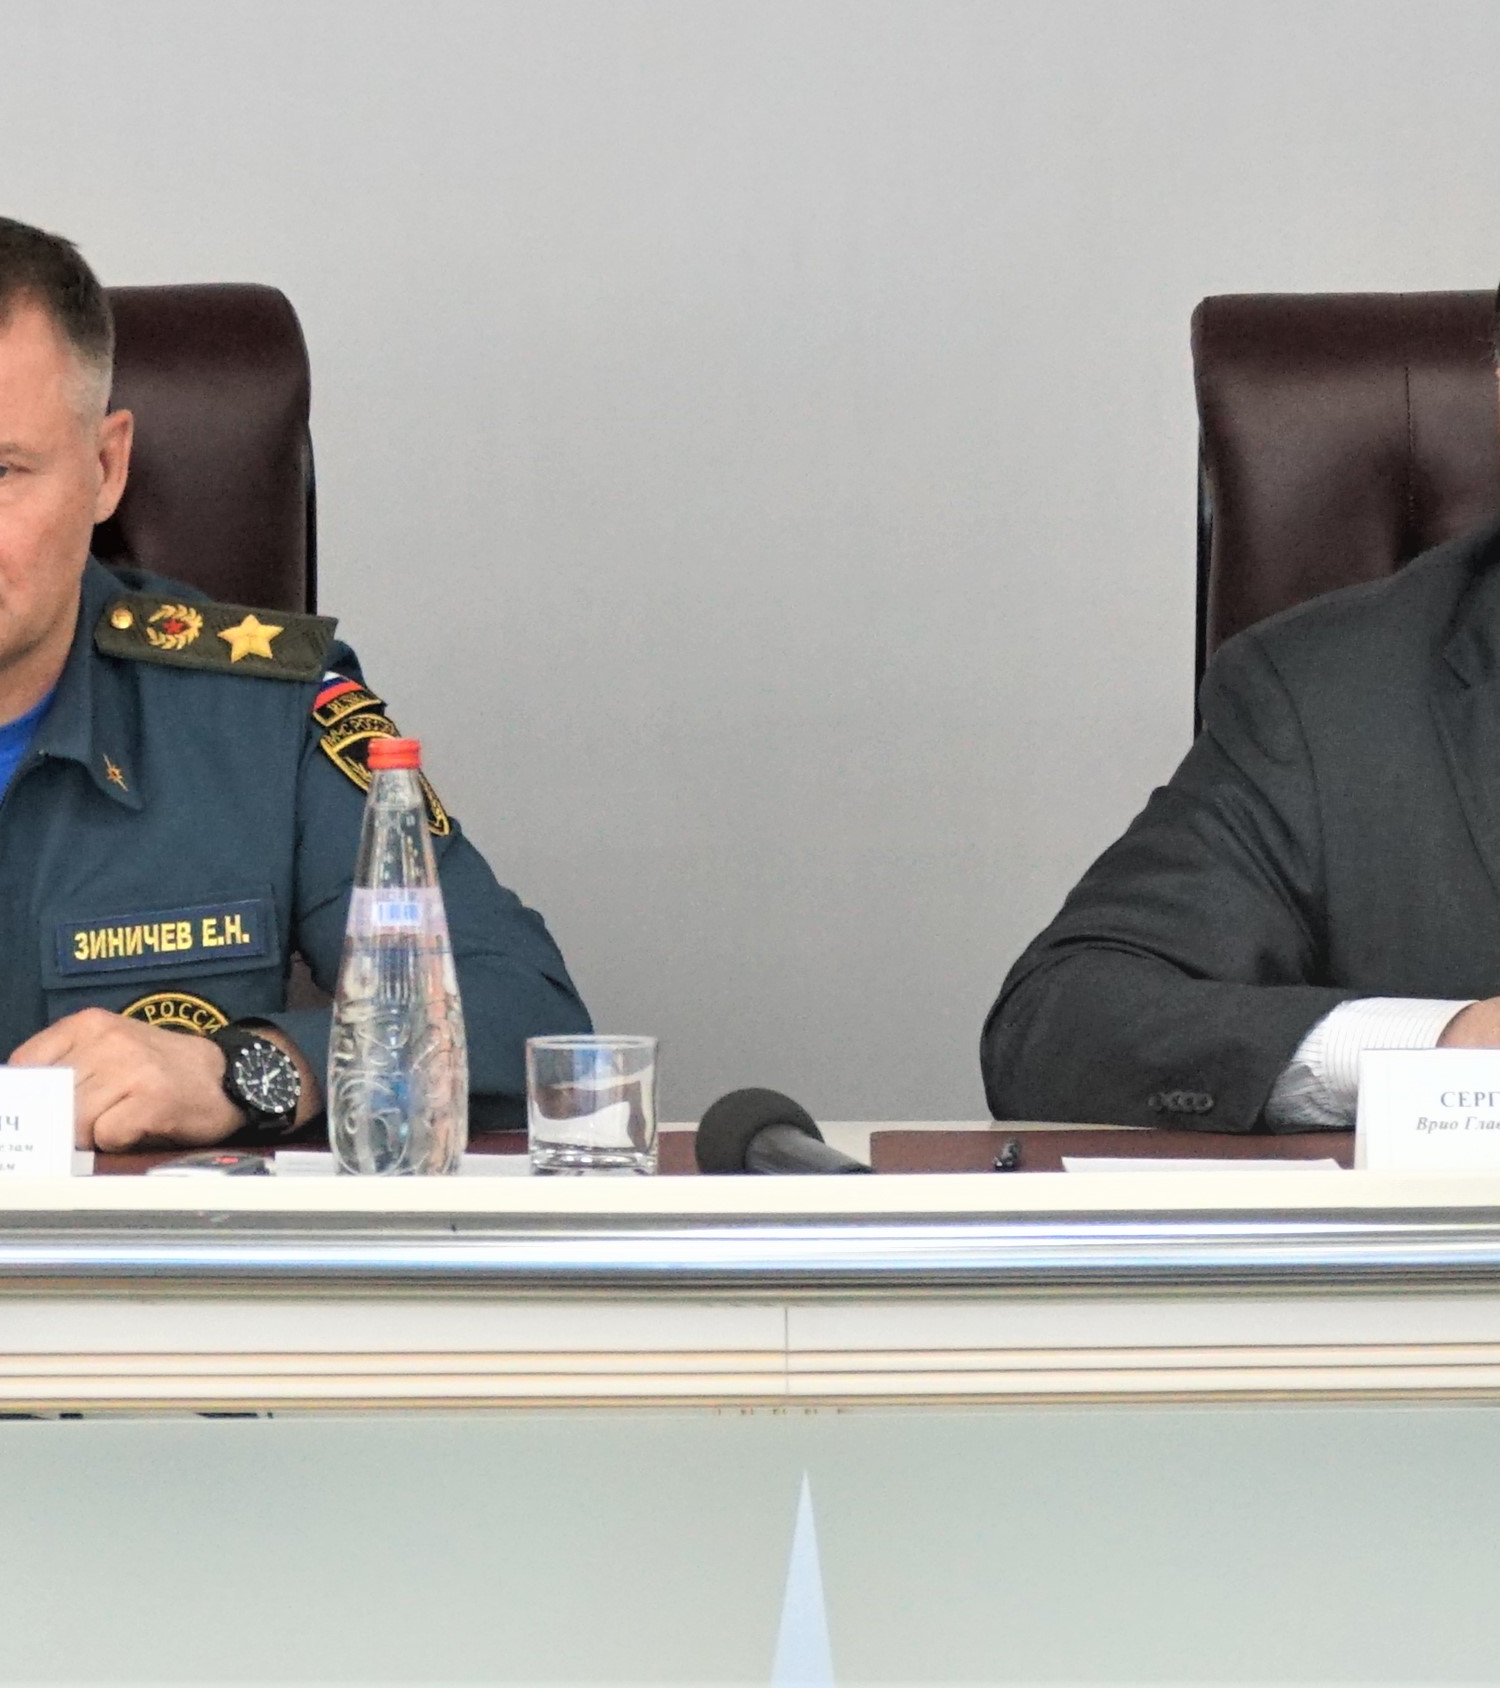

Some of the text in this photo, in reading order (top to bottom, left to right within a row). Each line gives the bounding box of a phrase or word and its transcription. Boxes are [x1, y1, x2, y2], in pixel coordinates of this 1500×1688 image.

[73, 913, 250, 961] ЗИНИЧЕВ Е.Н.
[143, 1000, 223, 1035] РОССИ
[1416, 1116, 1459, 1134] Врио
